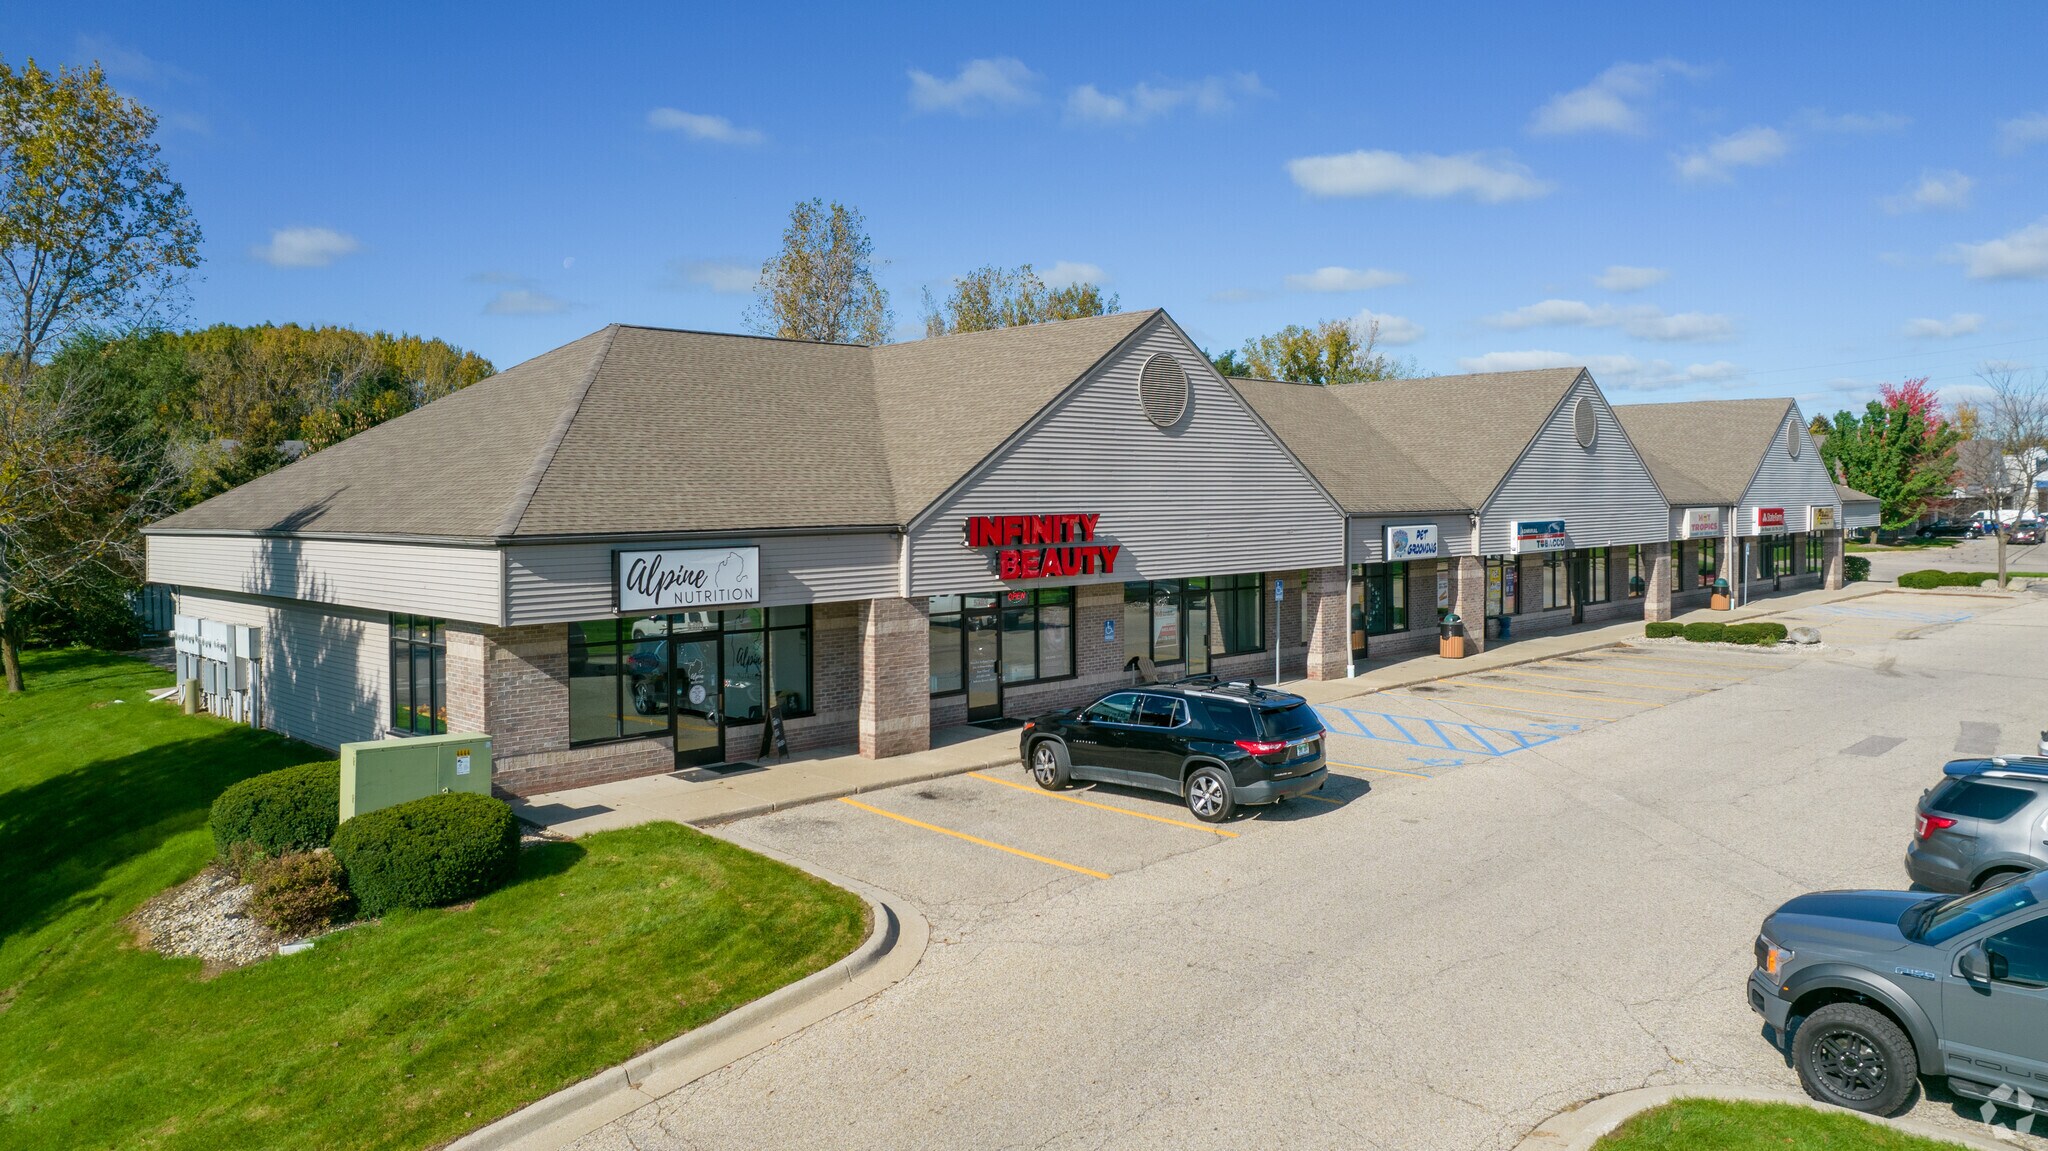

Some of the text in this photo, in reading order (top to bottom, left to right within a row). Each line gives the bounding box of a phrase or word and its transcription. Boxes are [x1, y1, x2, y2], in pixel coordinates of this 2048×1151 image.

[968, 514, 1100, 547] INFINITY
[1691, 522, 1718, 531] TROPICS
[1416, 529, 1429, 540] PET
[1407, 542, 1437, 555] GROOMING
[1536, 538, 1565, 549] TOBACCO
[999, 545, 1121, 580] BEAUTY
[626, 554, 709, 605] Alpine
[674, 588, 753, 604] NUTRITION
[1007, 592, 1027, 601] OPEN
[736, 646, 762, 673] Alpin
